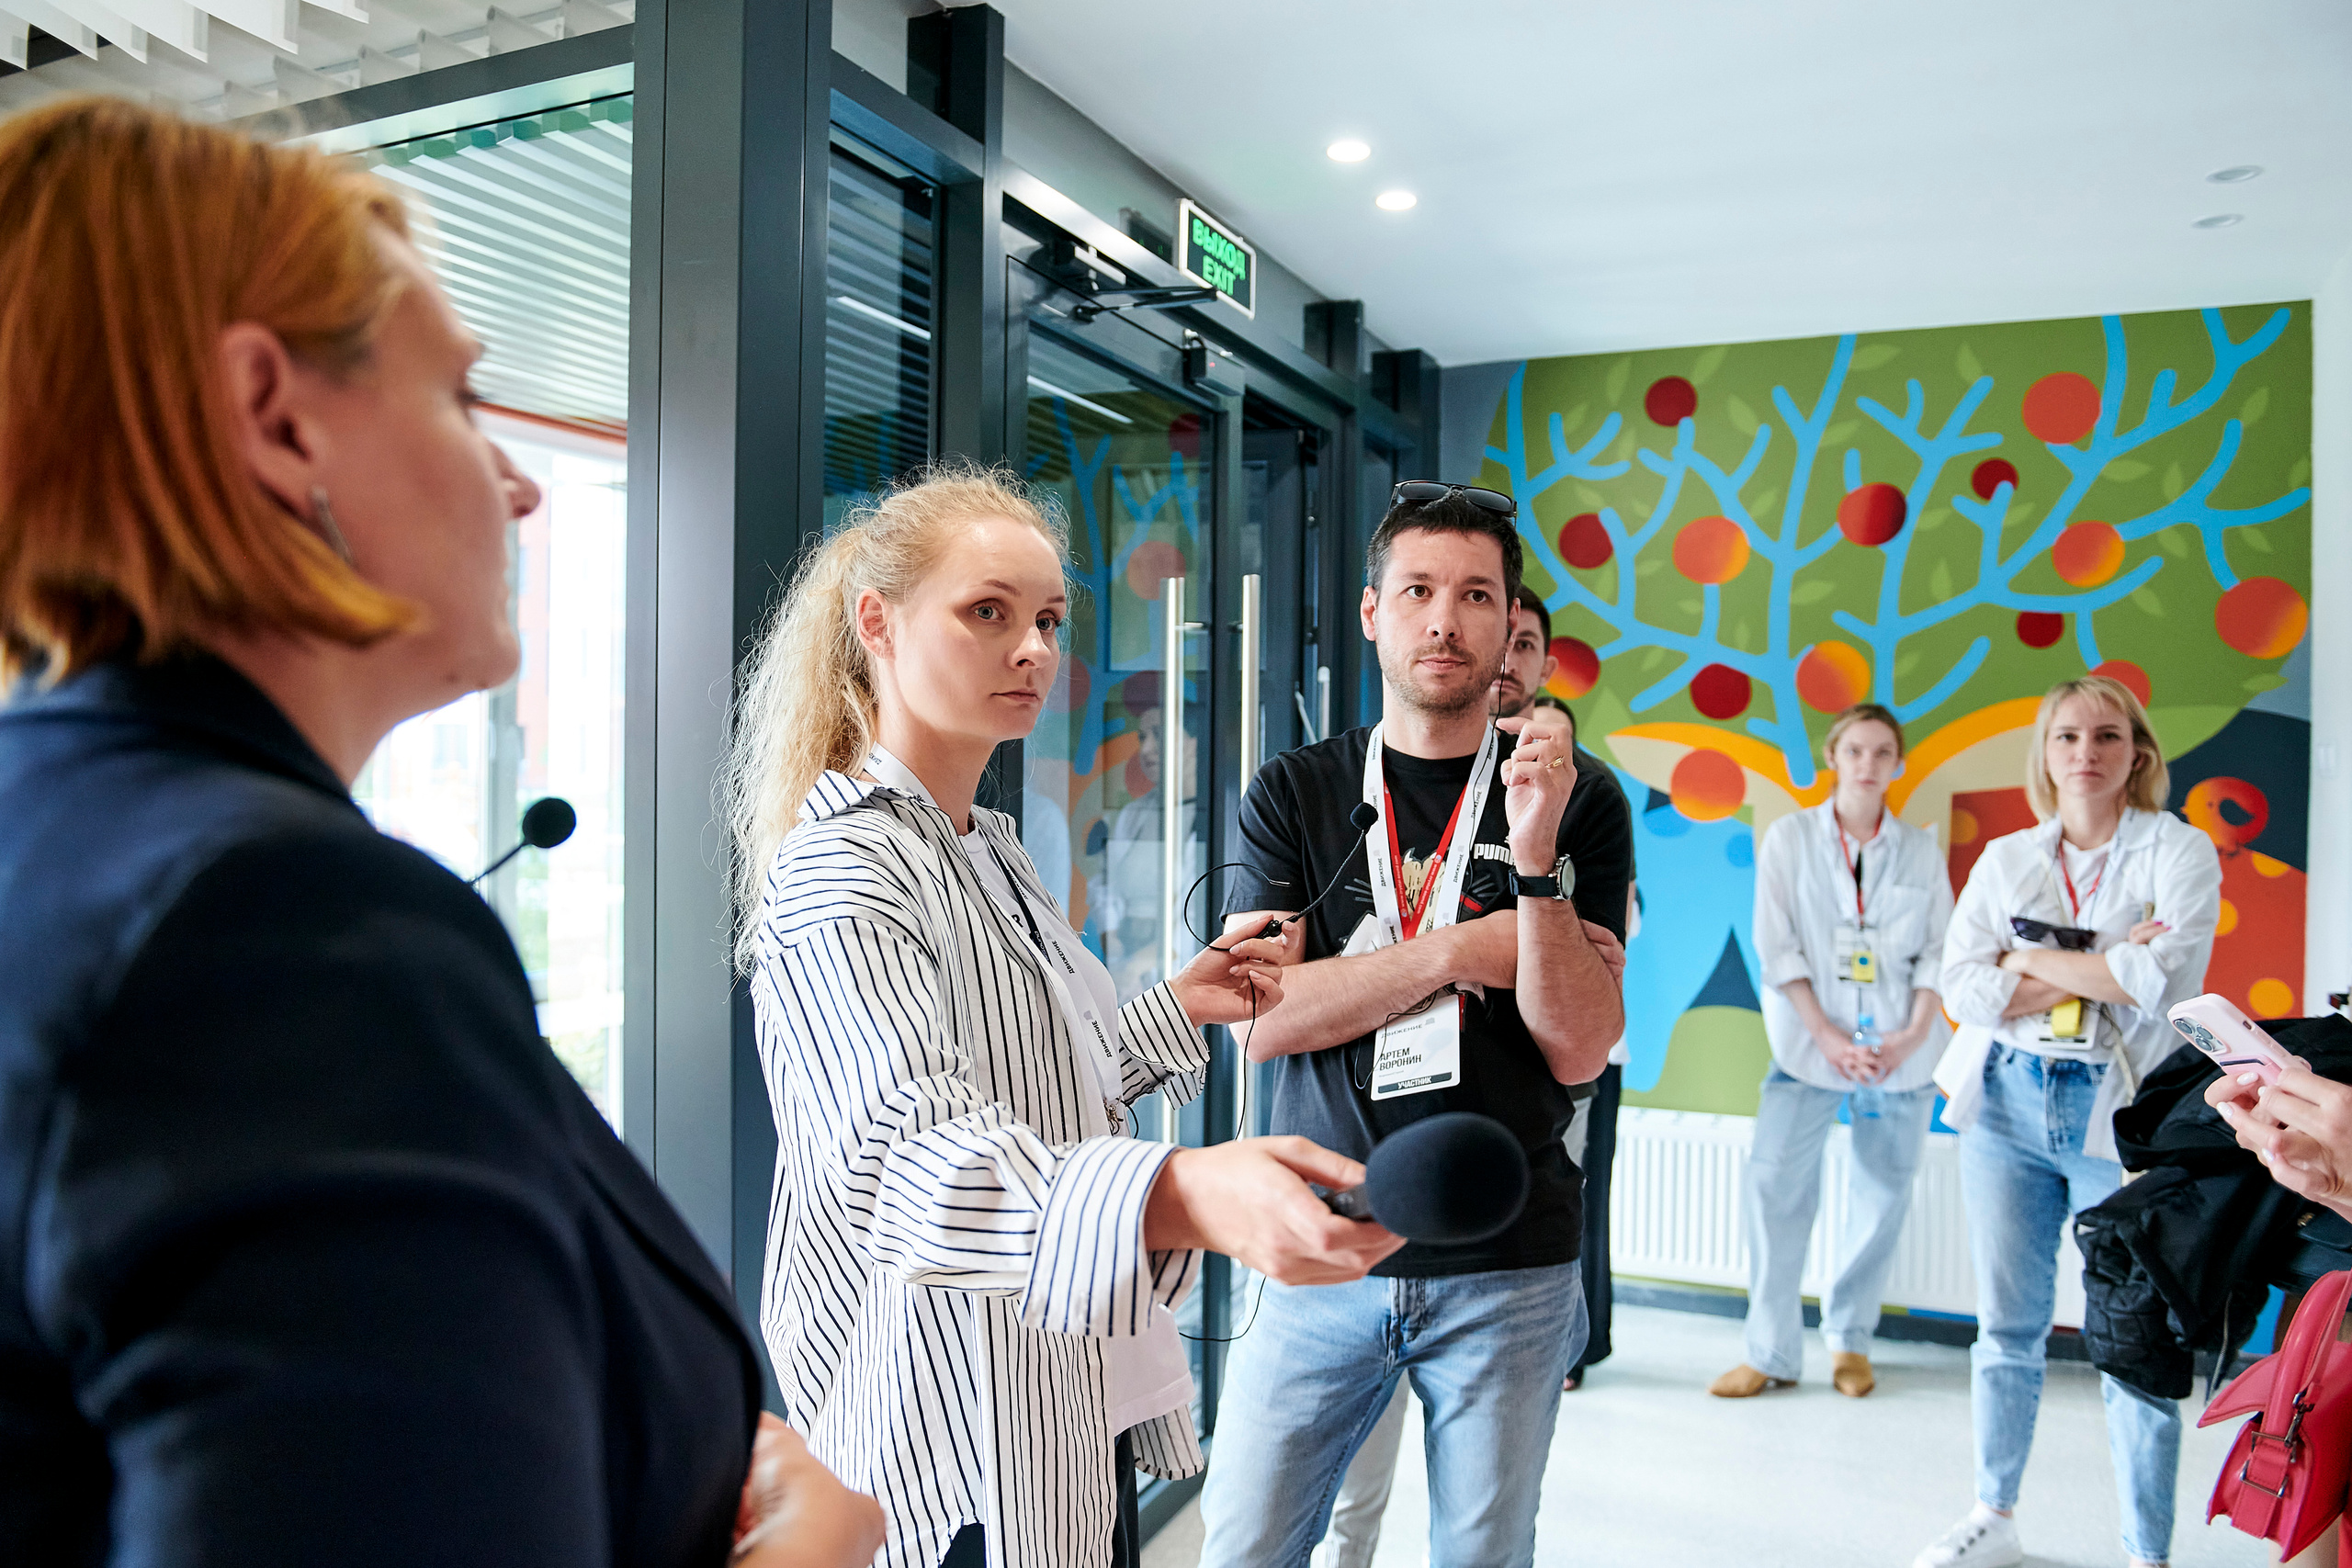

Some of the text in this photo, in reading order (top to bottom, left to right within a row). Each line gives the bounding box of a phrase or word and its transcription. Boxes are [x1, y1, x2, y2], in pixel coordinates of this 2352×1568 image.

[1193, 219, 1246, 280] ВЫХОД
[1203, 255, 1236, 296] EXIT
[1378, 858, 1386, 886] ДВИЖЕНИЕ
[1453, 854, 1464, 883] ДВИЖЕНИЕ
[1051, 940, 1075, 974] ДВИЖЕНИЕ
[1091, 1021, 1113, 1057] ДВИЖЕНИЕ
[1379, 1055, 1422, 1071] ВОРОНИН
[1380, 1047, 1410, 1061] АРТЕМ
[1397, 1077, 1432, 1089] УЧАСТНИК
